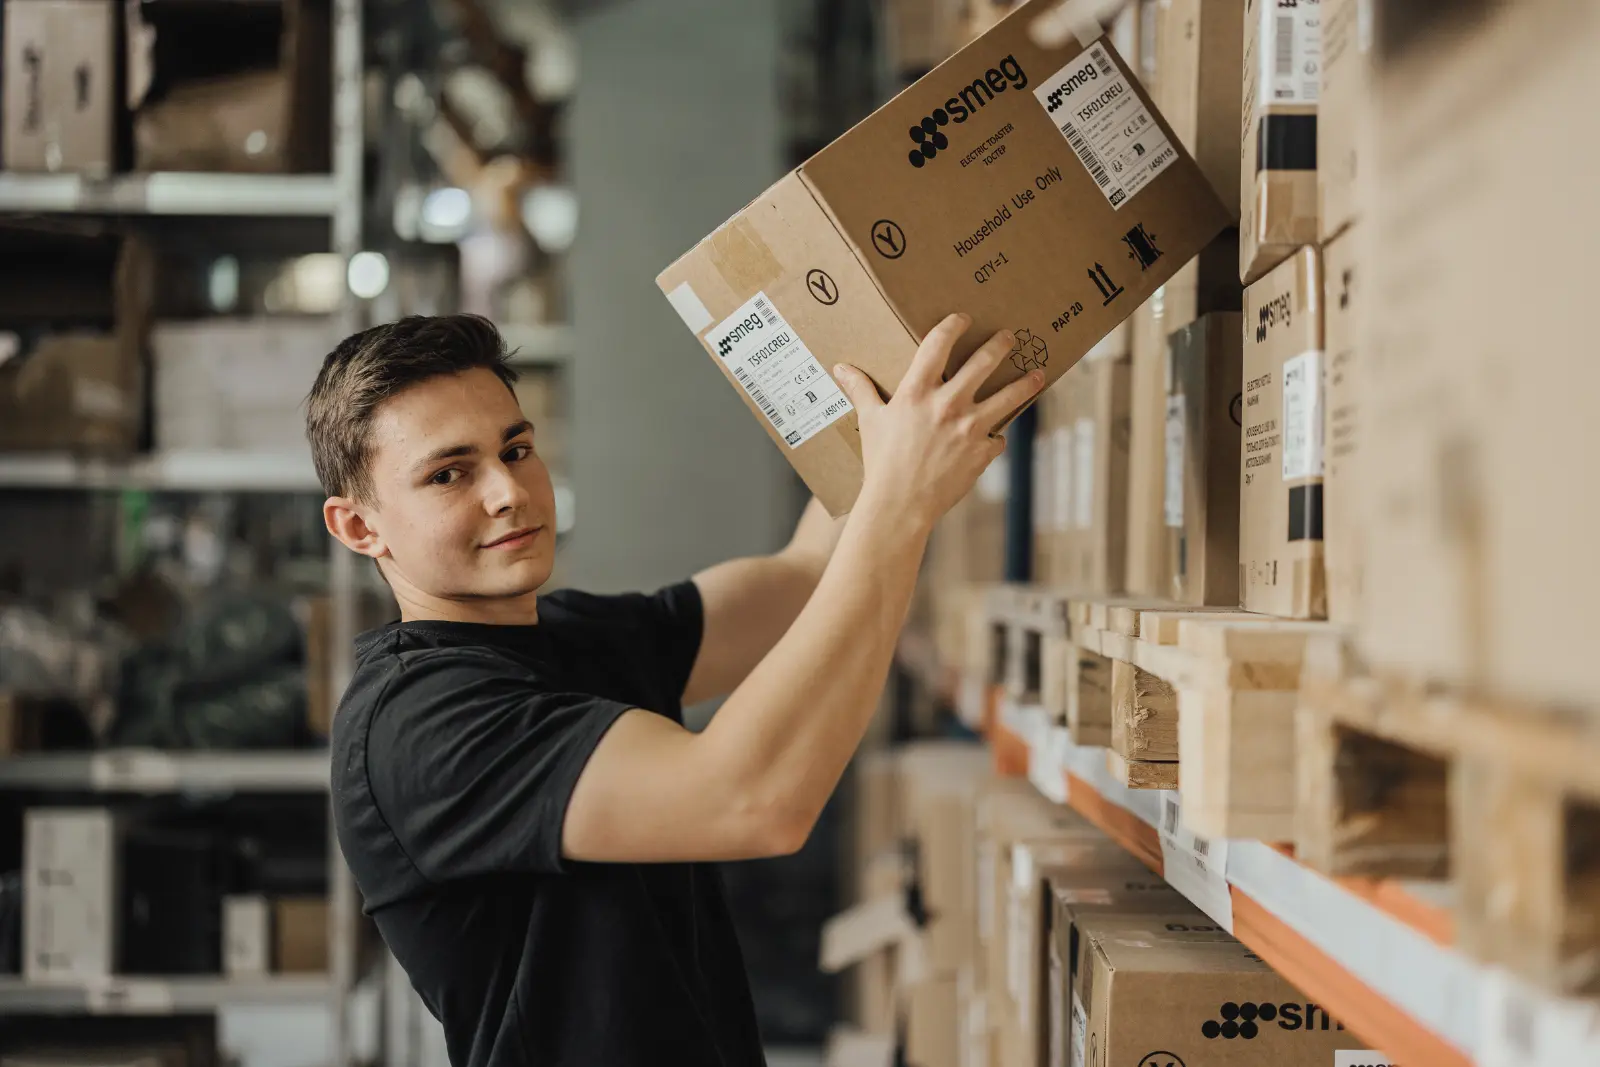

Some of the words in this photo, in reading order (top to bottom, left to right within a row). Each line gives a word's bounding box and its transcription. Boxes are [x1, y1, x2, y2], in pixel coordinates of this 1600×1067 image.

[944, 54, 1029, 123] smeg
[1061, 62, 1097, 96] smeg
[1077, 83, 1124, 122] TSF01CREU
[960, 141, 989, 168] ELECTRIC
[987, 122, 1015, 148] TOASTER
[953, 205, 1013, 257] Household
[1012, 188, 1035, 210] Use
[1036, 166, 1064, 192] Only
[974, 252, 1009, 285] QTY=1
[729, 312, 763, 343] smeg
[1051, 312, 1074, 333] PAP
[1070, 301, 1084, 317] 20
[1269, 292, 1291, 328] smeg
[747, 332, 790, 368] TSF01CREU
[1278, 1003, 1344, 1031] sm
